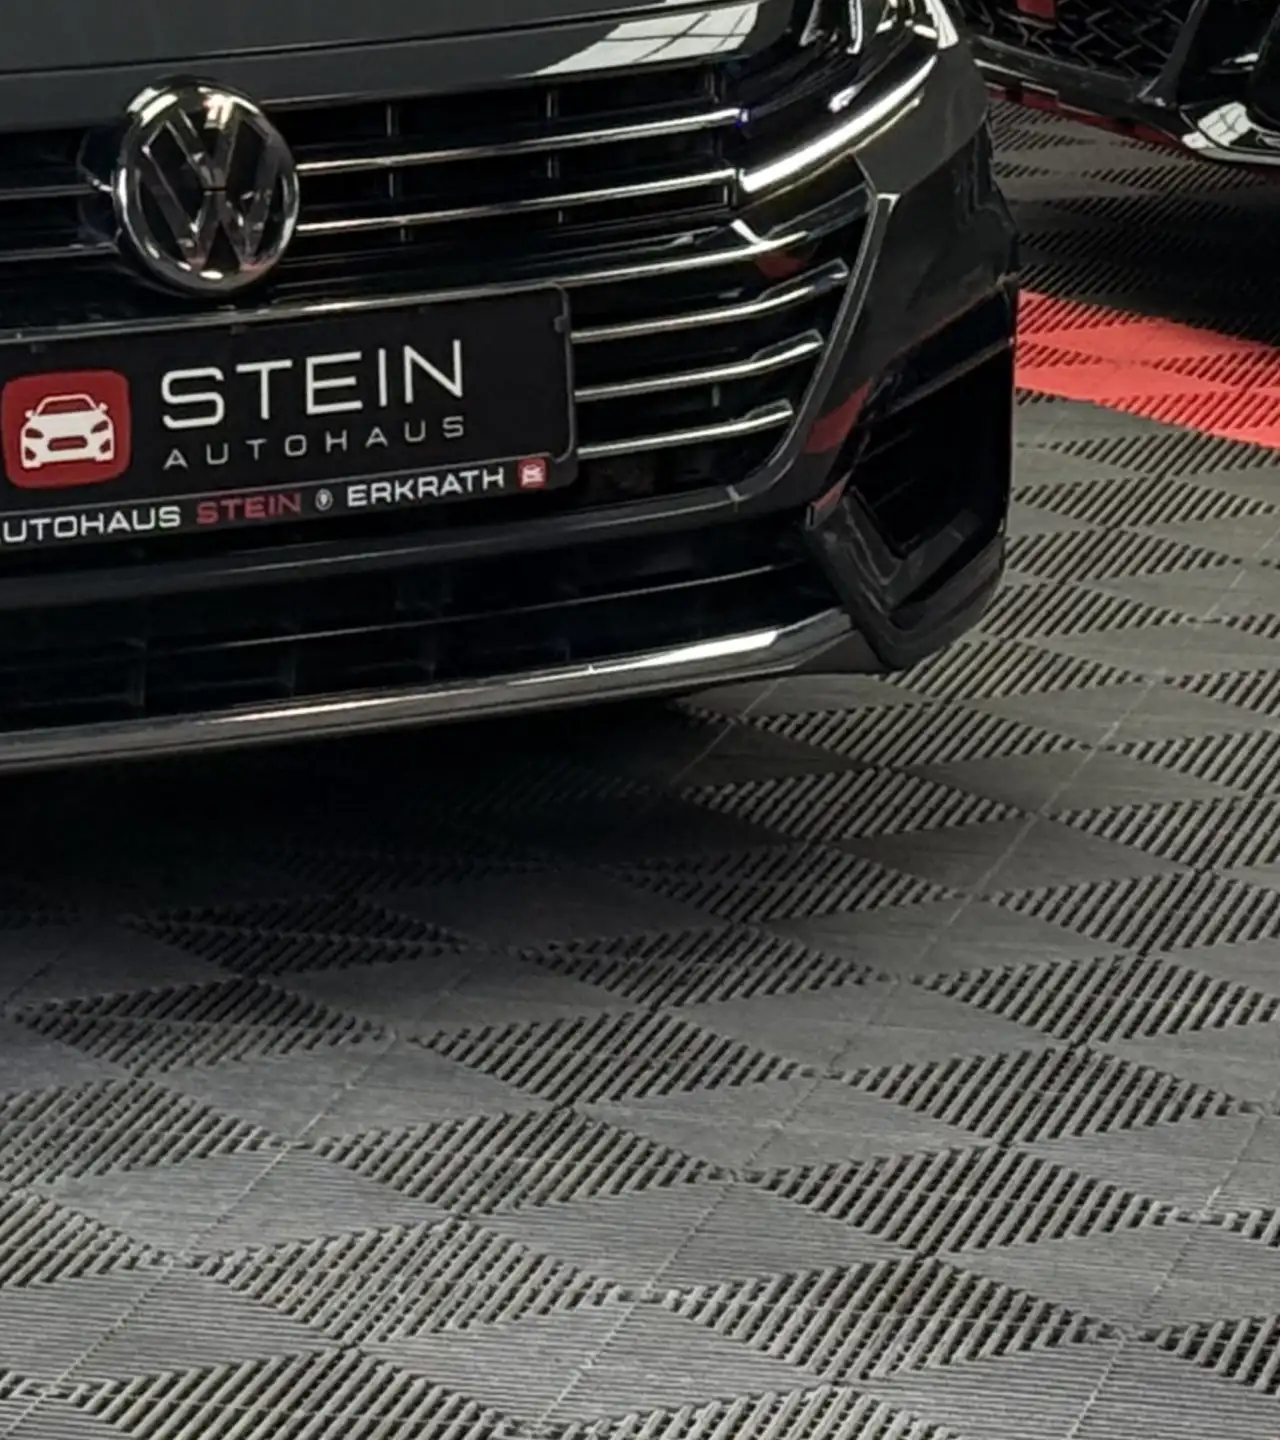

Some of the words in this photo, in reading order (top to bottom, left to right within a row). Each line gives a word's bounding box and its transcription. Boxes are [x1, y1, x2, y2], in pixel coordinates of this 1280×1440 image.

[160, 338, 464, 429] STEIN
[162, 415, 465, 470] AUTOHAUS
[195, 492, 303, 525] STEIN
[346, 466, 505, 508] ERKRATH
